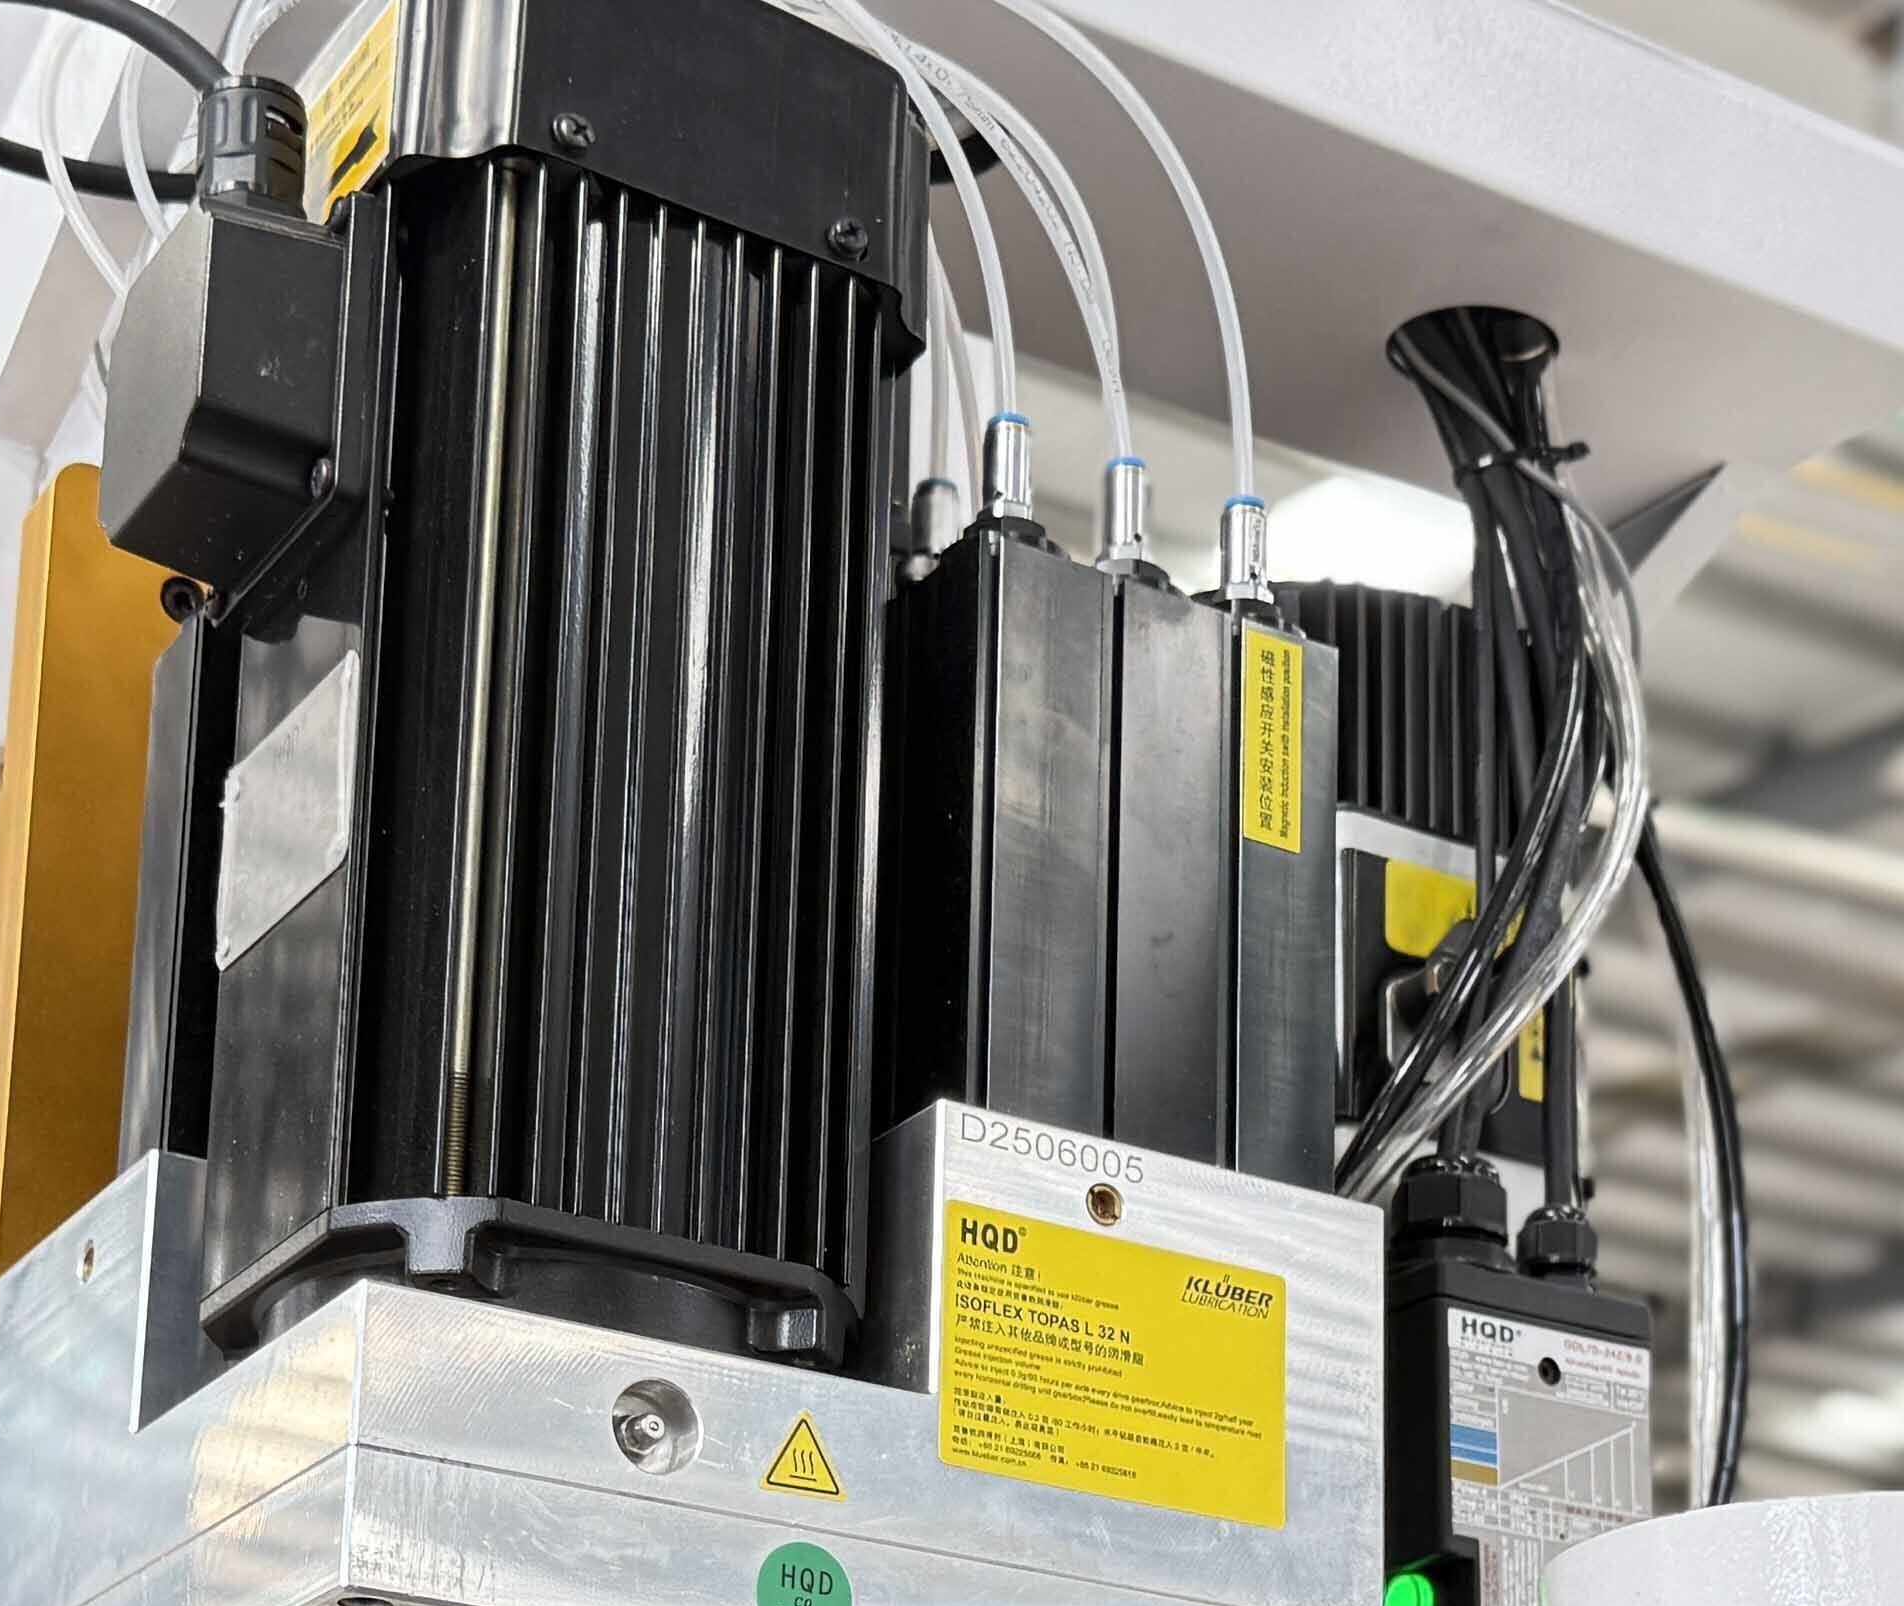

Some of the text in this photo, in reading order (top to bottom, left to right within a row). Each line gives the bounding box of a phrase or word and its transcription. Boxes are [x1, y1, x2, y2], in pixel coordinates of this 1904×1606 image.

[1260, 650, 1275, 831] 磁性感应开关安装位置
[961, 1113, 1144, 1184] D2506005
[961, 1218, 1018, 1253] HQD
[1181, 1291, 1269, 1319] LUBRICATION
[1186, 1274, 1273, 1308] KLÜBER
[956, 1294, 1130, 1343] ISOFLEX TOPAS L 32 N
[1462, 1316, 1514, 1342] HQD
[781, 1563, 833, 1595] HQD
